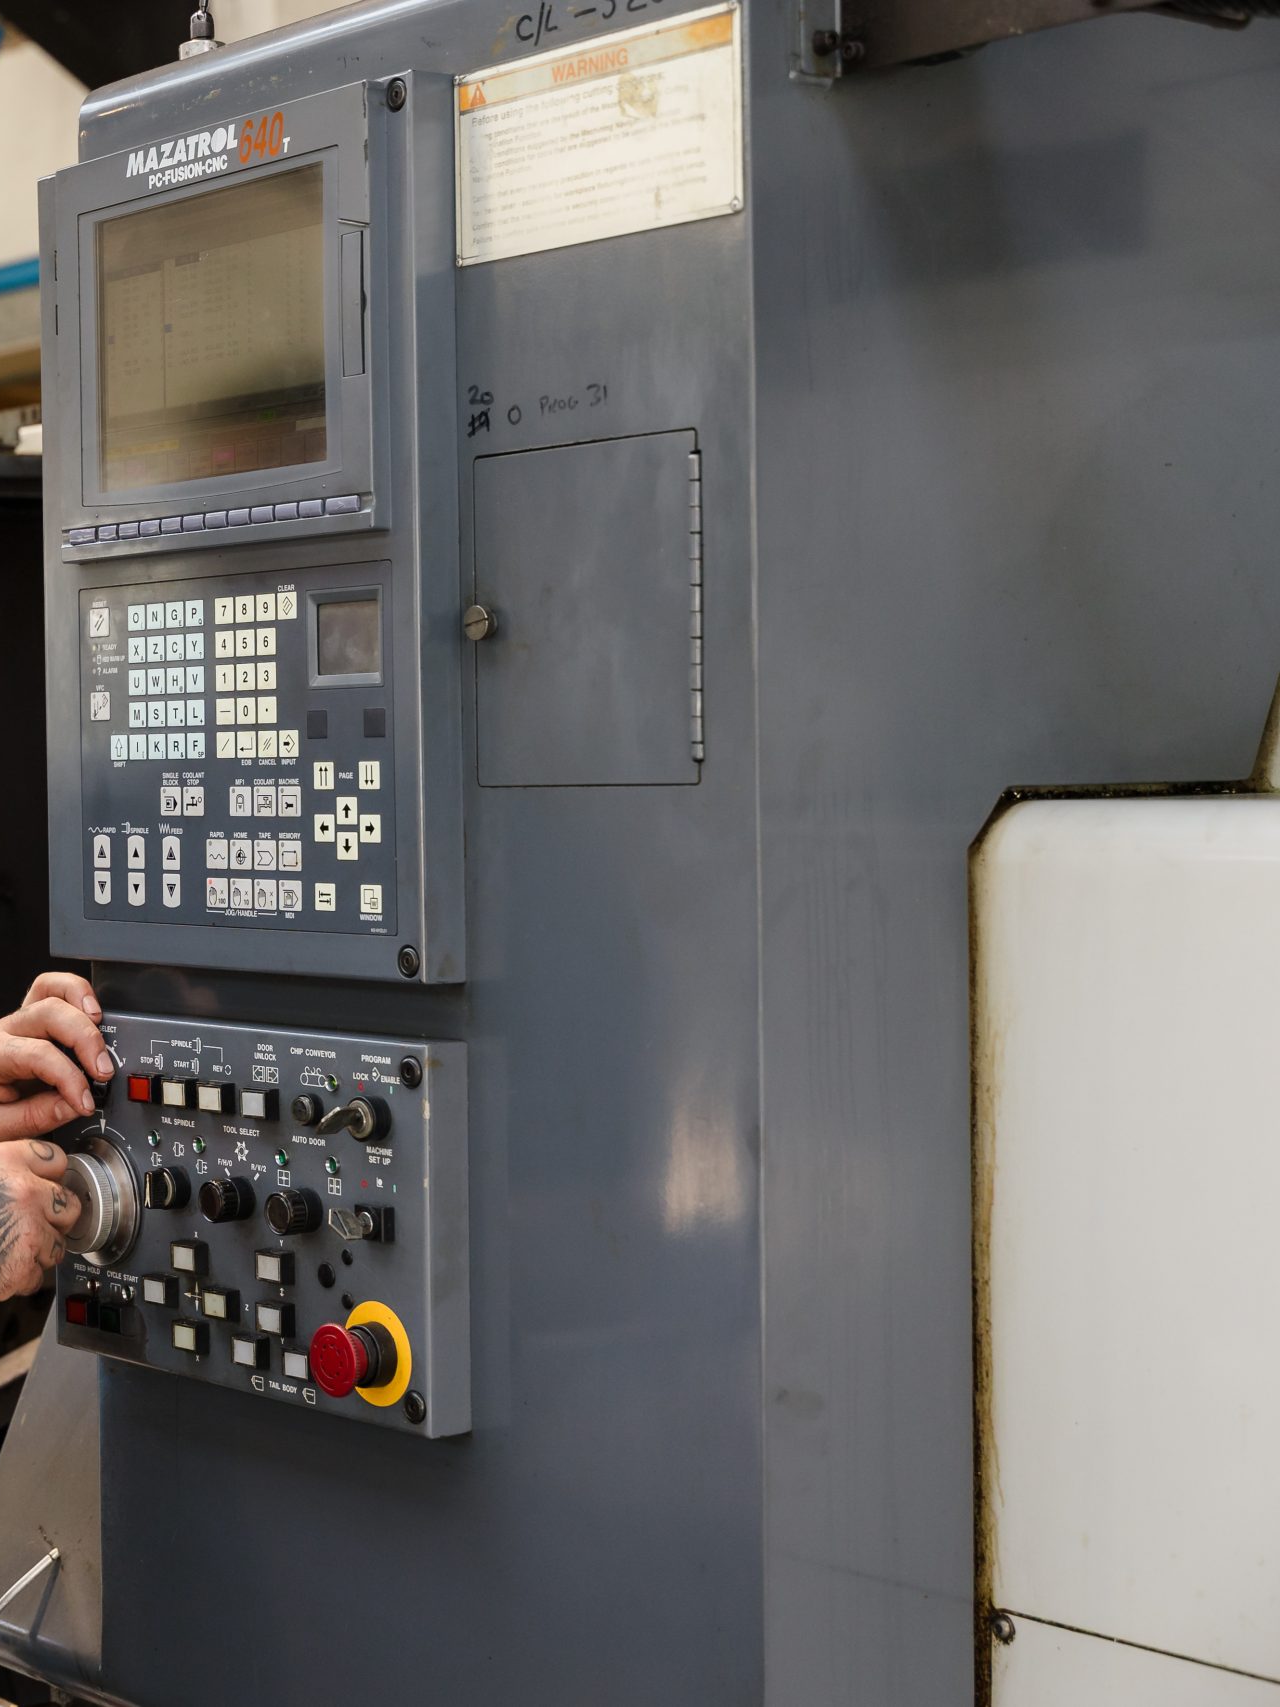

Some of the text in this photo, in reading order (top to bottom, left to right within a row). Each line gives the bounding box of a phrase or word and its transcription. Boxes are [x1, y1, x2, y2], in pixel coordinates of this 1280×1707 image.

[515, 0, 558, 46] C/L
[551, 48, 628, 83] WARNING
[471, 111, 498, 128] Before
[500, 105, 523, 121] using
[582, 82, 613, 101] cutting
[126, 111, 291, 178] MAZATROL 640 T
[148, 154, 228, 189] PC-FUSION-CNC
[468, 385, 494, 405] 20
[586, 383, 607, 407] 31
[277, 584, 295, 592] CLEAR
[151, 610, 158, 622] N
[171, 609, 178, 621] G
[191, 608, 197, 620] P
[221, 601, 269, 617] 7 8 9
[133, 640, 198, 657] X Z C Y
[221, 636, 269, 650] 4 5 6
[133, 674, 198, 688] U W H V
[222, 670, 269, 684] 1 2 3
[133, 707, 198, 720] M S T L
[154, 741, 160, 752] K
[173, 741, 179, 752] R
[193, 740, 198, 751] F
[281, 758, 297, 766] INPUT
[182, 771, 205, 779] COOLANT
[225, 909, 258, 918] JOG/HANDLE
[171, 1040, 192, 1048] SPINDLE
[257, 1043, 273, 1052] DOOR
[254, 1052, 276, 1061] UNLOCK
[290, 1047, 336, 1059] CHIP CONVEYOR
[140, 1056, 154, 1064] STOP
[174, 1060, 189, 1068] START
[361, 1054, 391, 1065] PROGRAM
[212, 1064, 223, 1073] REV
[353, 1072, 400, 1085] LOCK ENABLE
[161, 1116, 195, 1128] TAIL SPINDLE
[223, 1125, 260, 1137] TOOL SELECT
[292, 1135, 326, 1147] AUTO DOOR
[366, 1145, 393, 1157] MACHINE
[369, 1156, 391, 1166] SET UP
[279, 1239, 284, 1247] Y
[74, 1263, 100, 1275] FEED HOLD
[106, 1270, 139, 1284] CYCLE START
[269, 1380, 298, 1394] TAIL BODY
